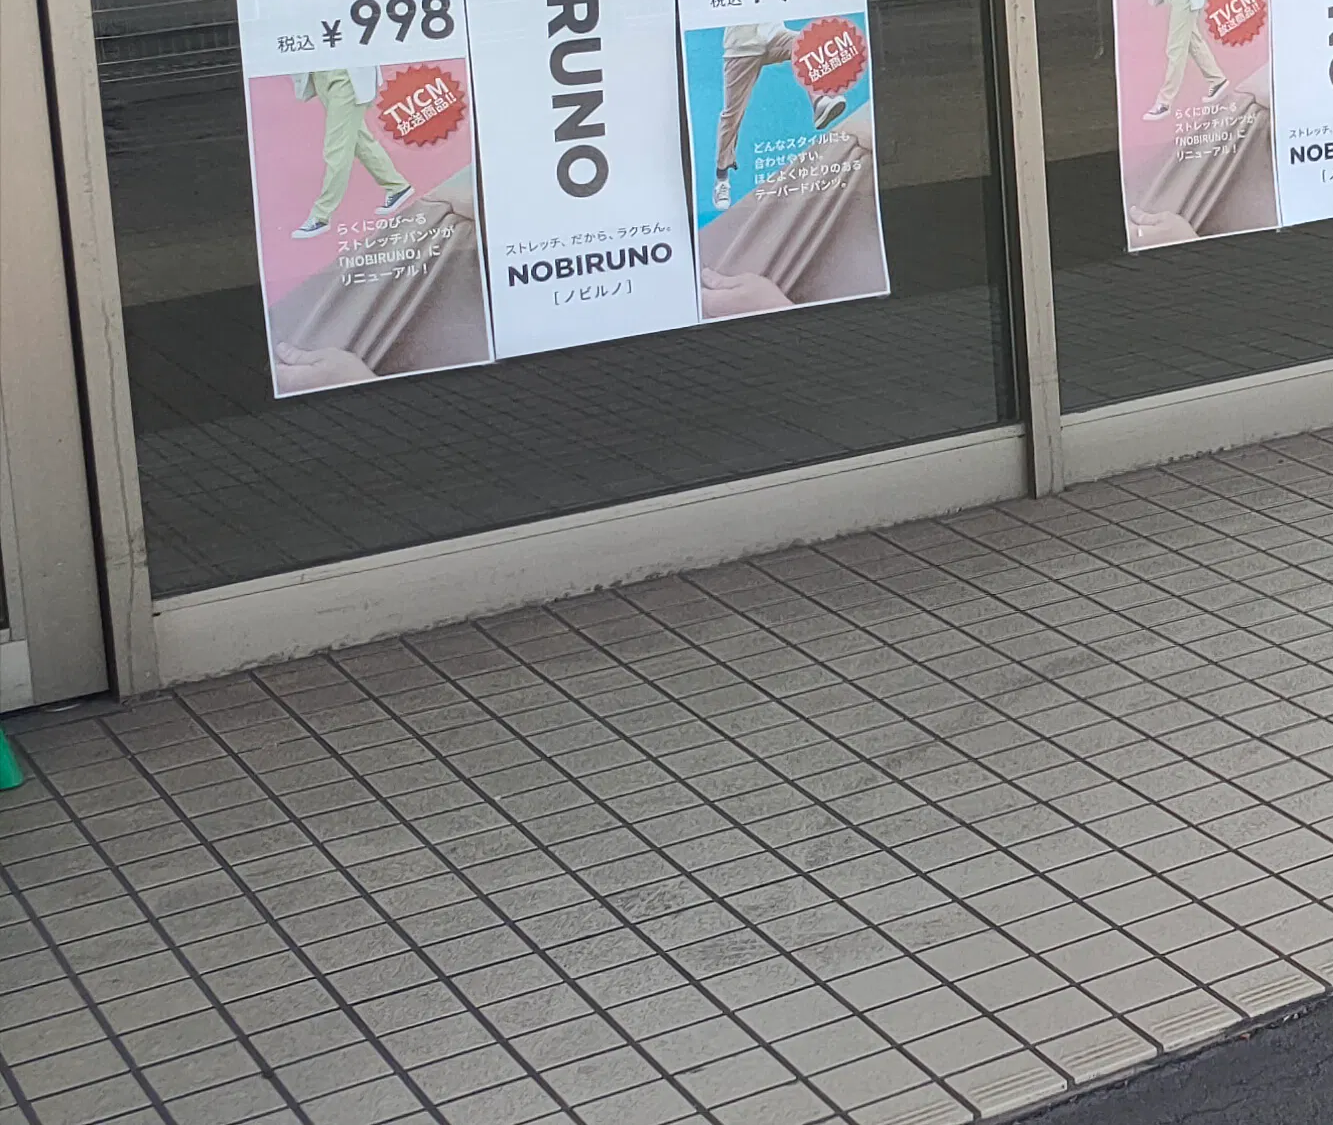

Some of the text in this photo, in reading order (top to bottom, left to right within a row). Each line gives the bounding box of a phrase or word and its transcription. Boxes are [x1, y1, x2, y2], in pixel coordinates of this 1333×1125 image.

[278, 35, 315, 52] 税込
[799, 31, 853, 71] TVCM
[384, 78, 449, 124] TVCM
[754, 131, 850, 154] どんなスタイルにも
[338, 226, 454, 252] ストレッチパンツが
[508, 242, 672, 287] NOBIRUNO
[554, 280, 633, 305] [ノビルノ]
